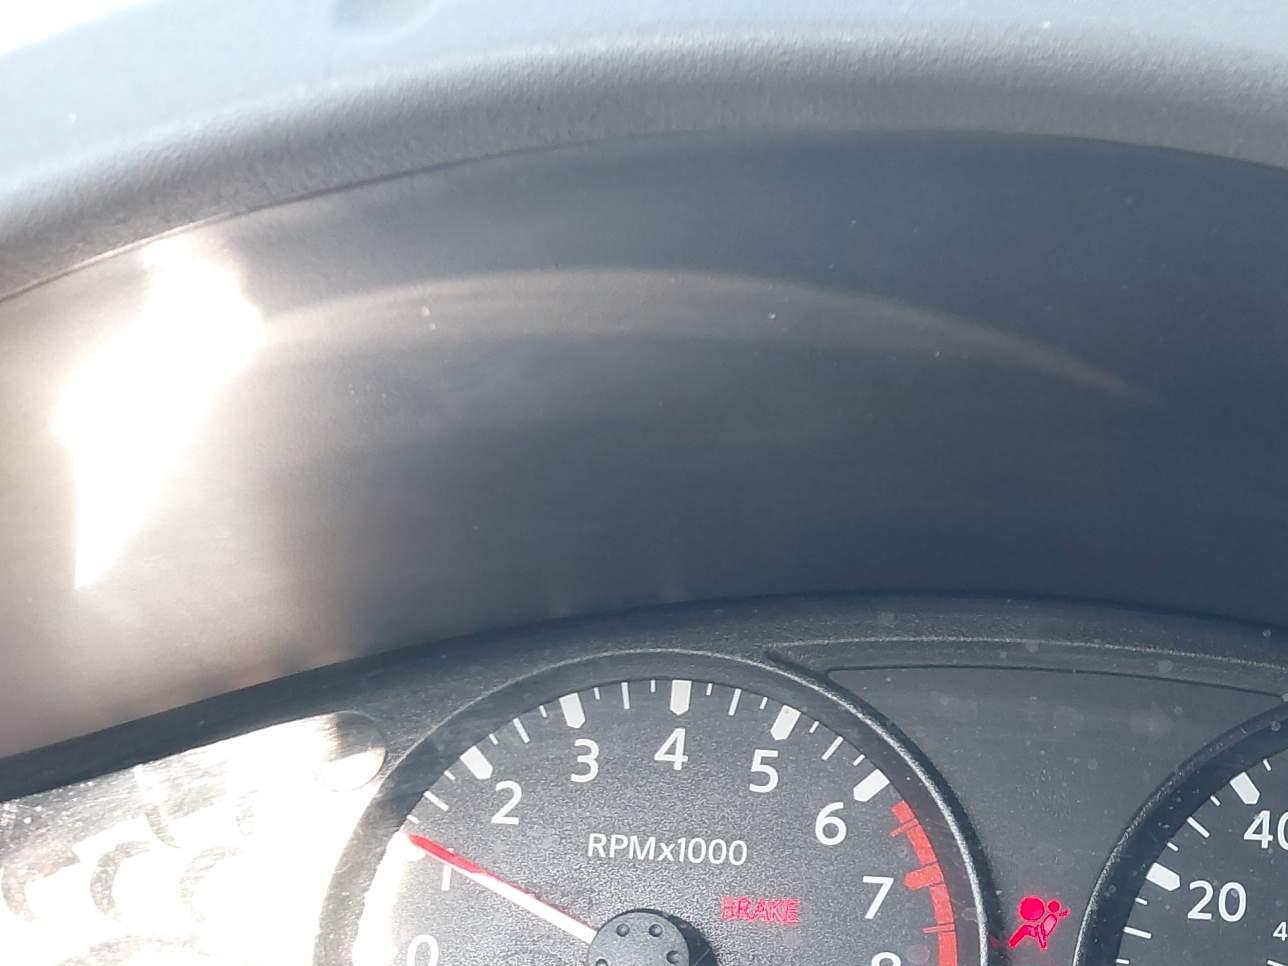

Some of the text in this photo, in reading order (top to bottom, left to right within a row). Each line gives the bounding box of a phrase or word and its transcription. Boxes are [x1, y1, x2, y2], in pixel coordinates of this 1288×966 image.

[570, 739, 600, 783] 3
[654, 727, 688, 770] 4
[749, 749, 780, 793] 5
[491, 780, 524, 825] 2
[815, 801, 848, 845] 6
[587, 832, 748, 867] RPMx1000
[721, 896, 800, 927] BRAKE
[862, 876, 895, 920] 7
[1186, 881, 1247, 922] 20
